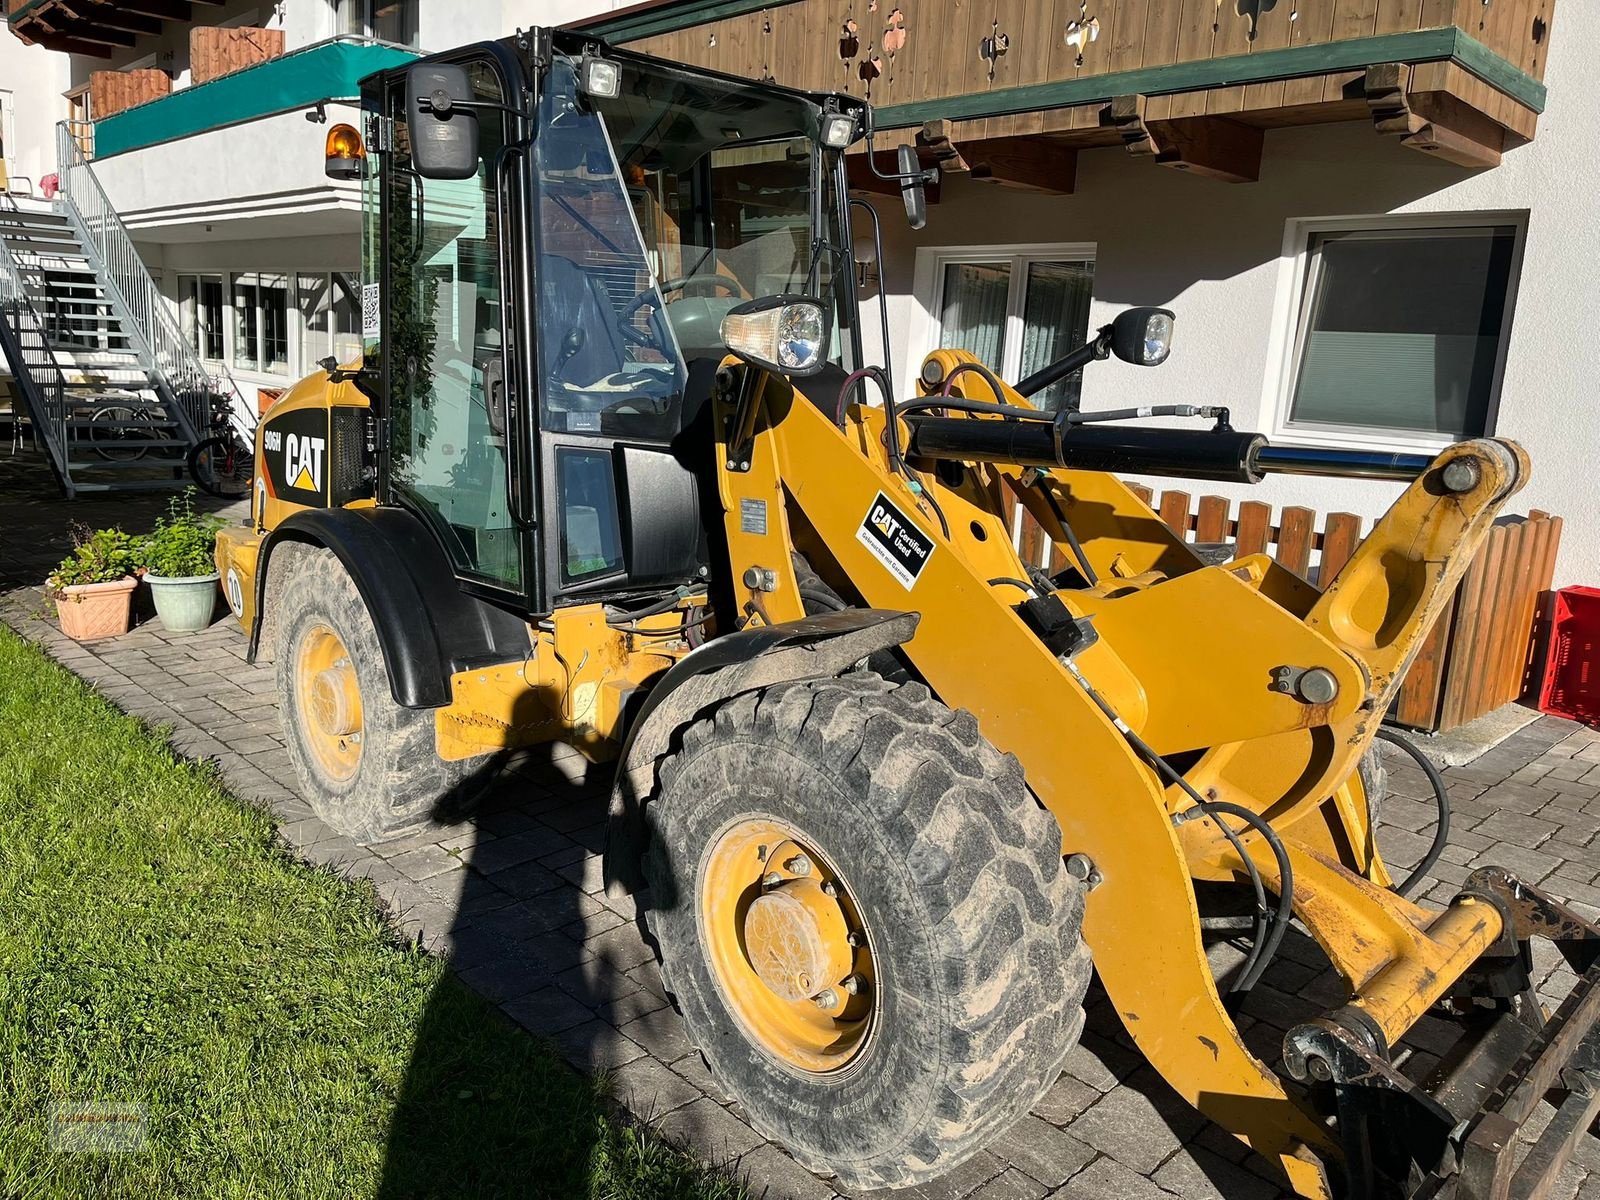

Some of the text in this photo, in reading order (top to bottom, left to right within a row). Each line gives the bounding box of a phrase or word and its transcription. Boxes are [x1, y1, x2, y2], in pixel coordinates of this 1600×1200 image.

[285, 433, 325, 493] CAT
[871, 505, 899, 539] CAT
[894, 537, 912, 557] Used
[898, 529, 927, 558] Certified
[884, 555, 893, 565] mit
[891, 561, 910, 583] Garantie
